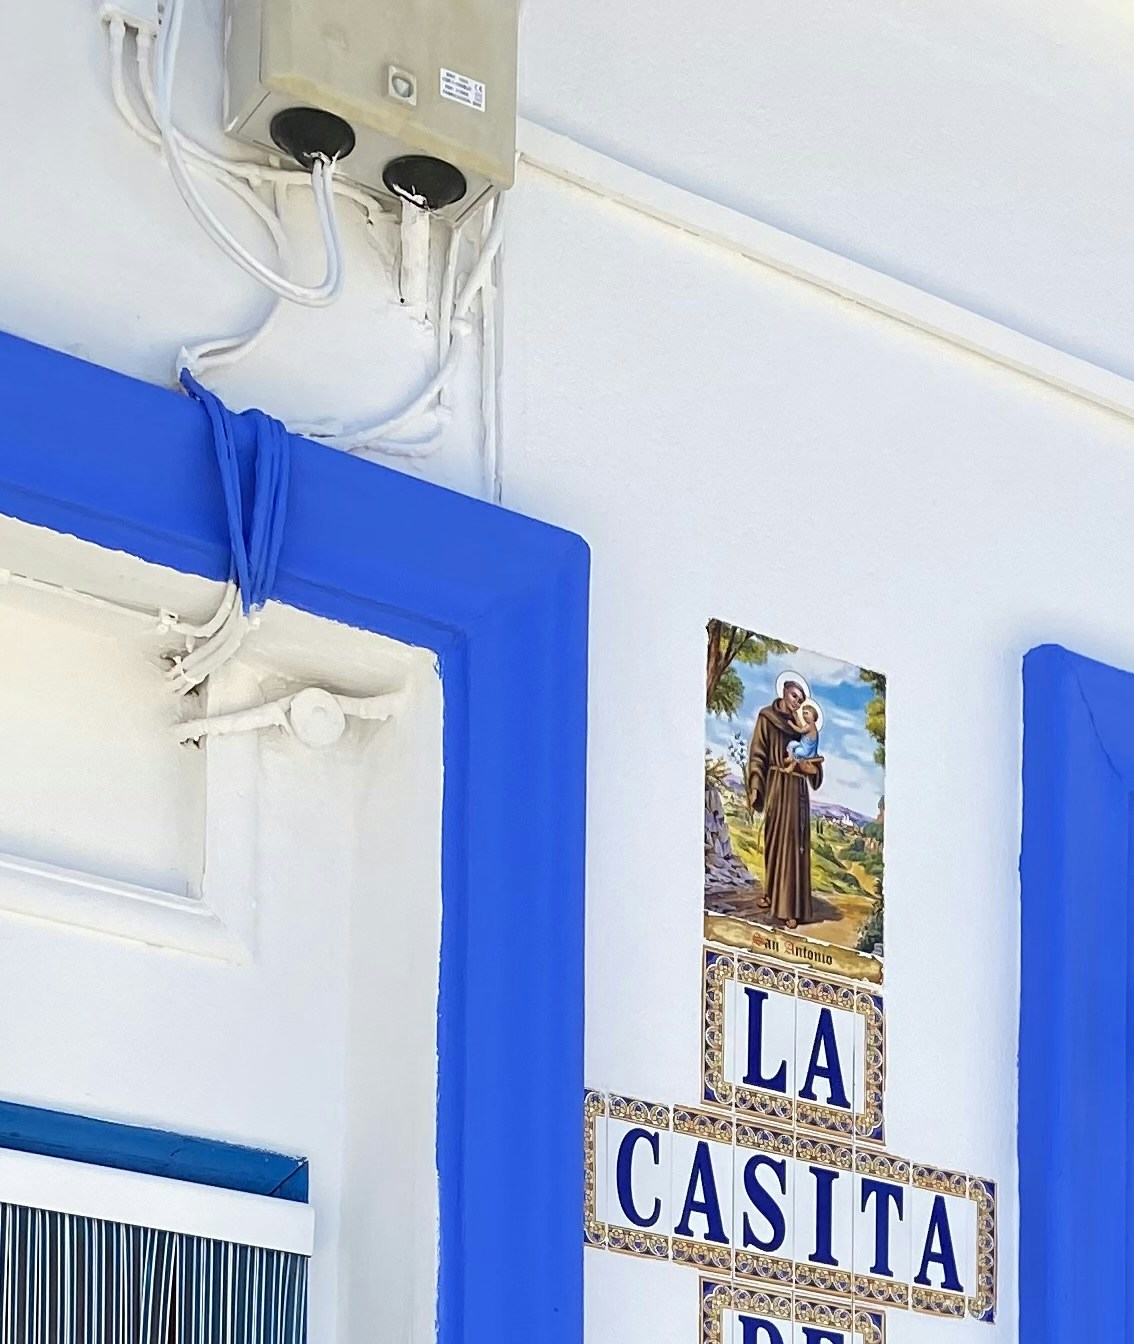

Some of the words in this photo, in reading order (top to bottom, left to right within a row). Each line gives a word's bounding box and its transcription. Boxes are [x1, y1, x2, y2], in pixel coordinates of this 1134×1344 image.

[752, 932, 779, 952] San
[784, 940, 833, 966] Antonio
[742, 986, 851, 1110] LA
[616, 1127, 964, 1293] CASITA
